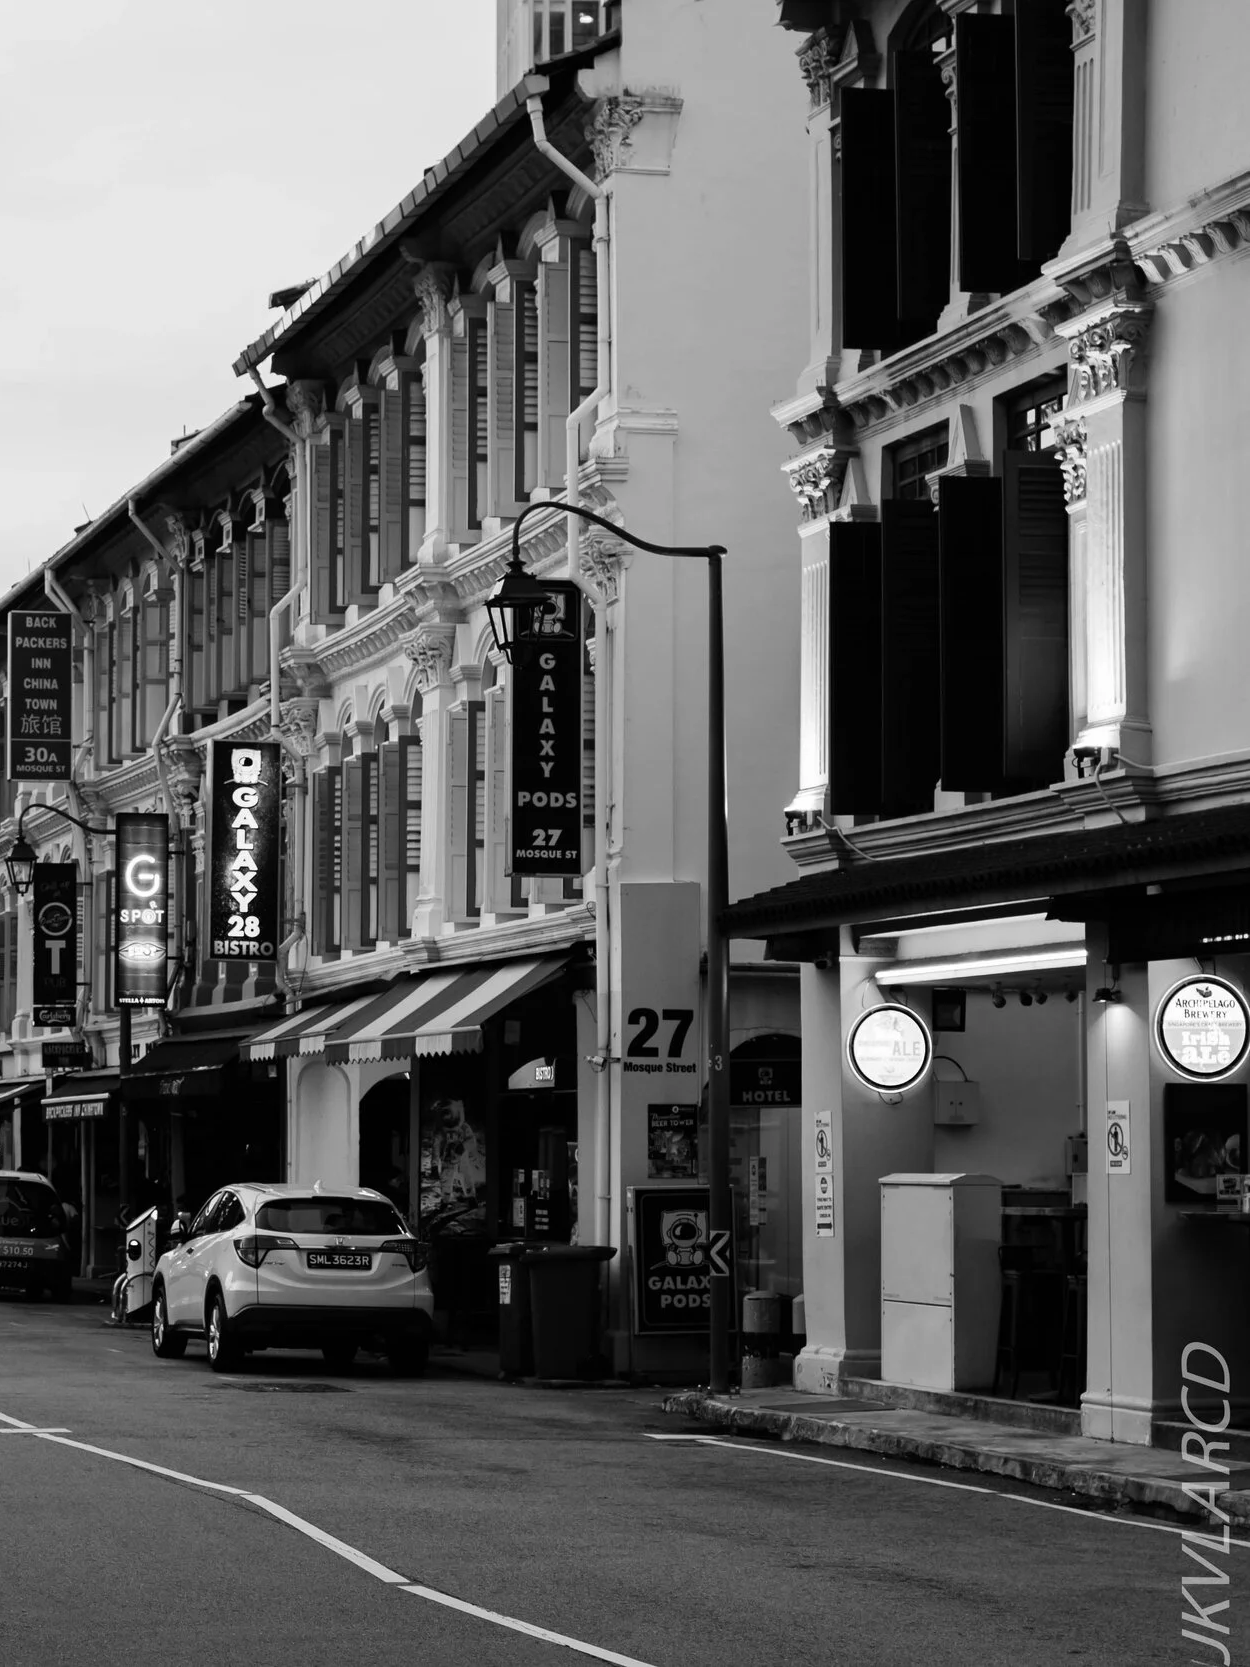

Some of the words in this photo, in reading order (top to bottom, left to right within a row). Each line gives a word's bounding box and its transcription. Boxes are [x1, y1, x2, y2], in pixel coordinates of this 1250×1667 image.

[25, 616, 57, 629] BACK
[15, 636, 68, 649] PACKERS
[31, 657, 52, 669] INN
[23, 677, 59, 690] CHINA
[25, 698, 58, 711] TOWN
[538, 652, 556, 778] GALAXY
[20, 714, 62, 735] 旅馆
[24, 746, 58, 763] 30A
[16, 764, 53, 773] MOSQUE
[55, 764, 66, 773] ST
[517, 791, 578, 808] PODS
[532, 828, 563, 847] 27
[230, 786, 259, 913] GALAXY
[515, 849, 563, 859] MOSQUE
[565, 849, 578, 859] ST
[124, 854, 161, 898] G
[227, 915, 261, 938] 28
[213, 940, 275, 956] BISTRO
[1175, 998, 1236, 1009] ARCHIPELAGO
[39, 1009, 72, 1024] Carlsberg
[1184, 1008, 1228, 1019] BREWERY
[627, 1007, 694, 1059] 27
[892, 1040, 922, 1057] ALE
[623, 1061, 664, 1074] Mosque
[665, 1061, 698, 1073] Street
[742, 1090, 792, 1103] HOTEL
[647, 1275, 711, 1290] GALAX
[660, 1293, 711, 1308] PODS
